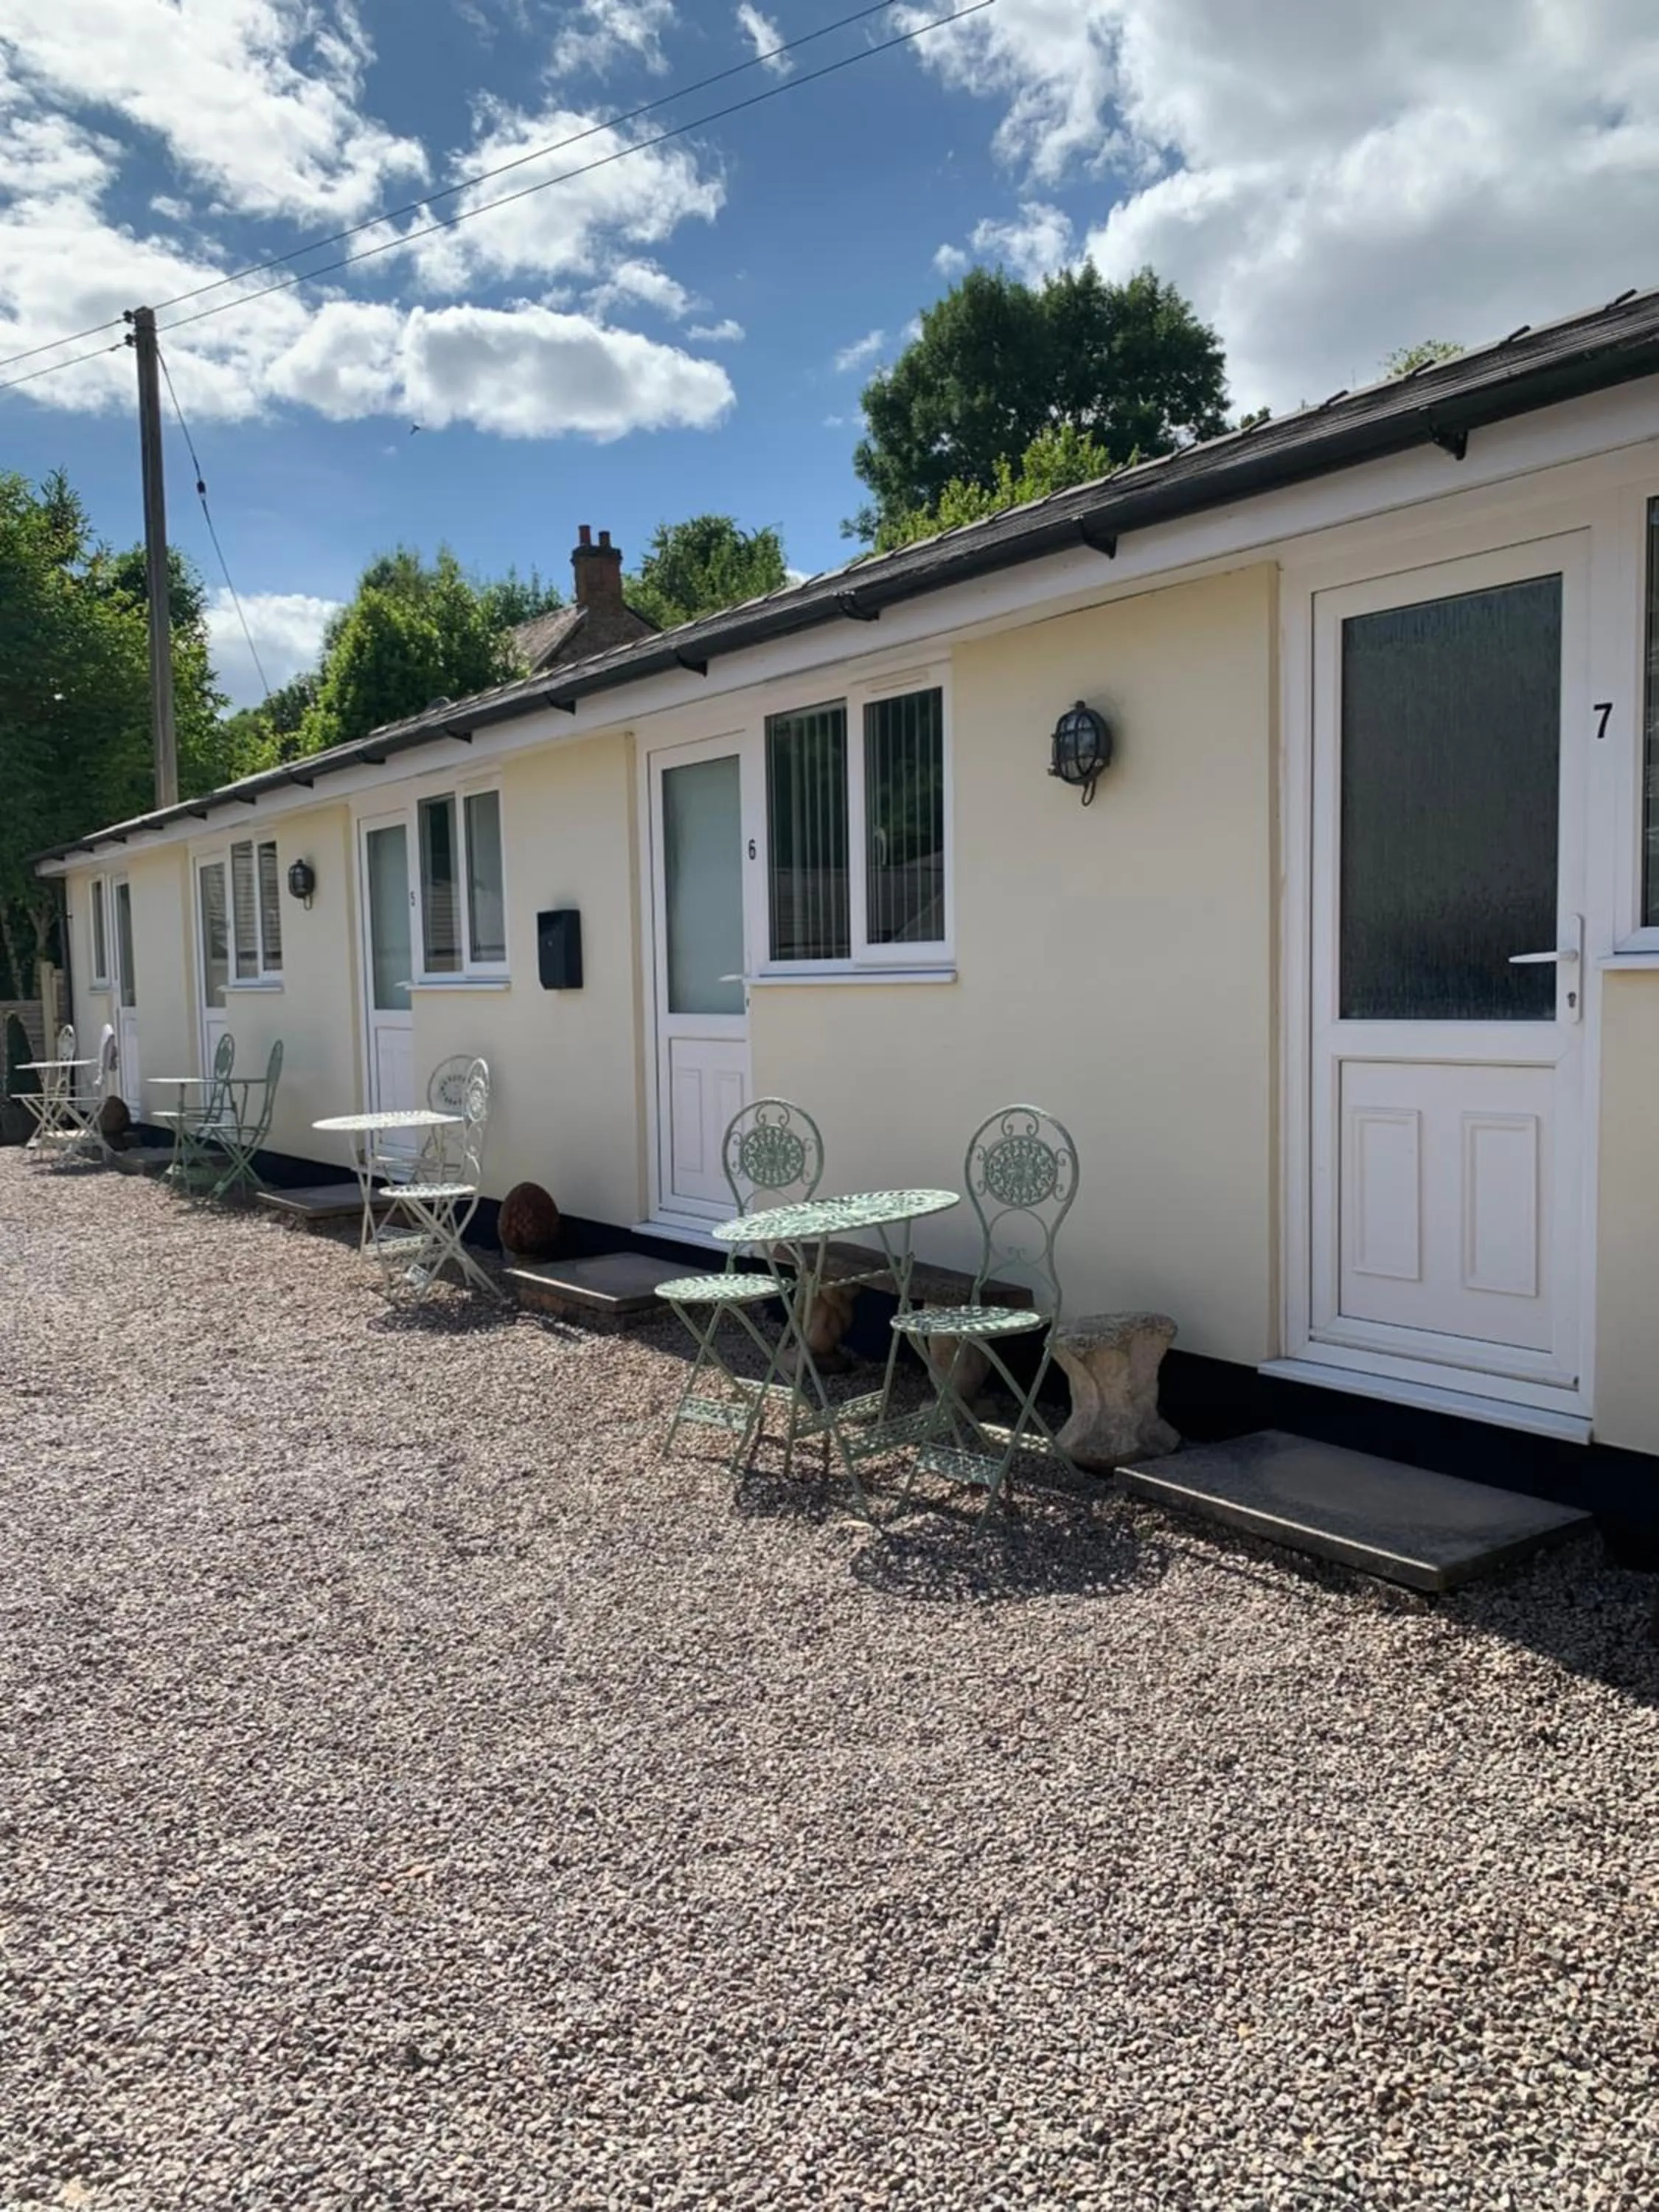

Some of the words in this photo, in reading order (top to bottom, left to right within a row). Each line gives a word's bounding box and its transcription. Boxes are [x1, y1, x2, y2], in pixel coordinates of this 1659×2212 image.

[1593, 702, 1613, 740] 7
[748, 838, 757, 860] 6
[410, 890, 416, 907] 5
